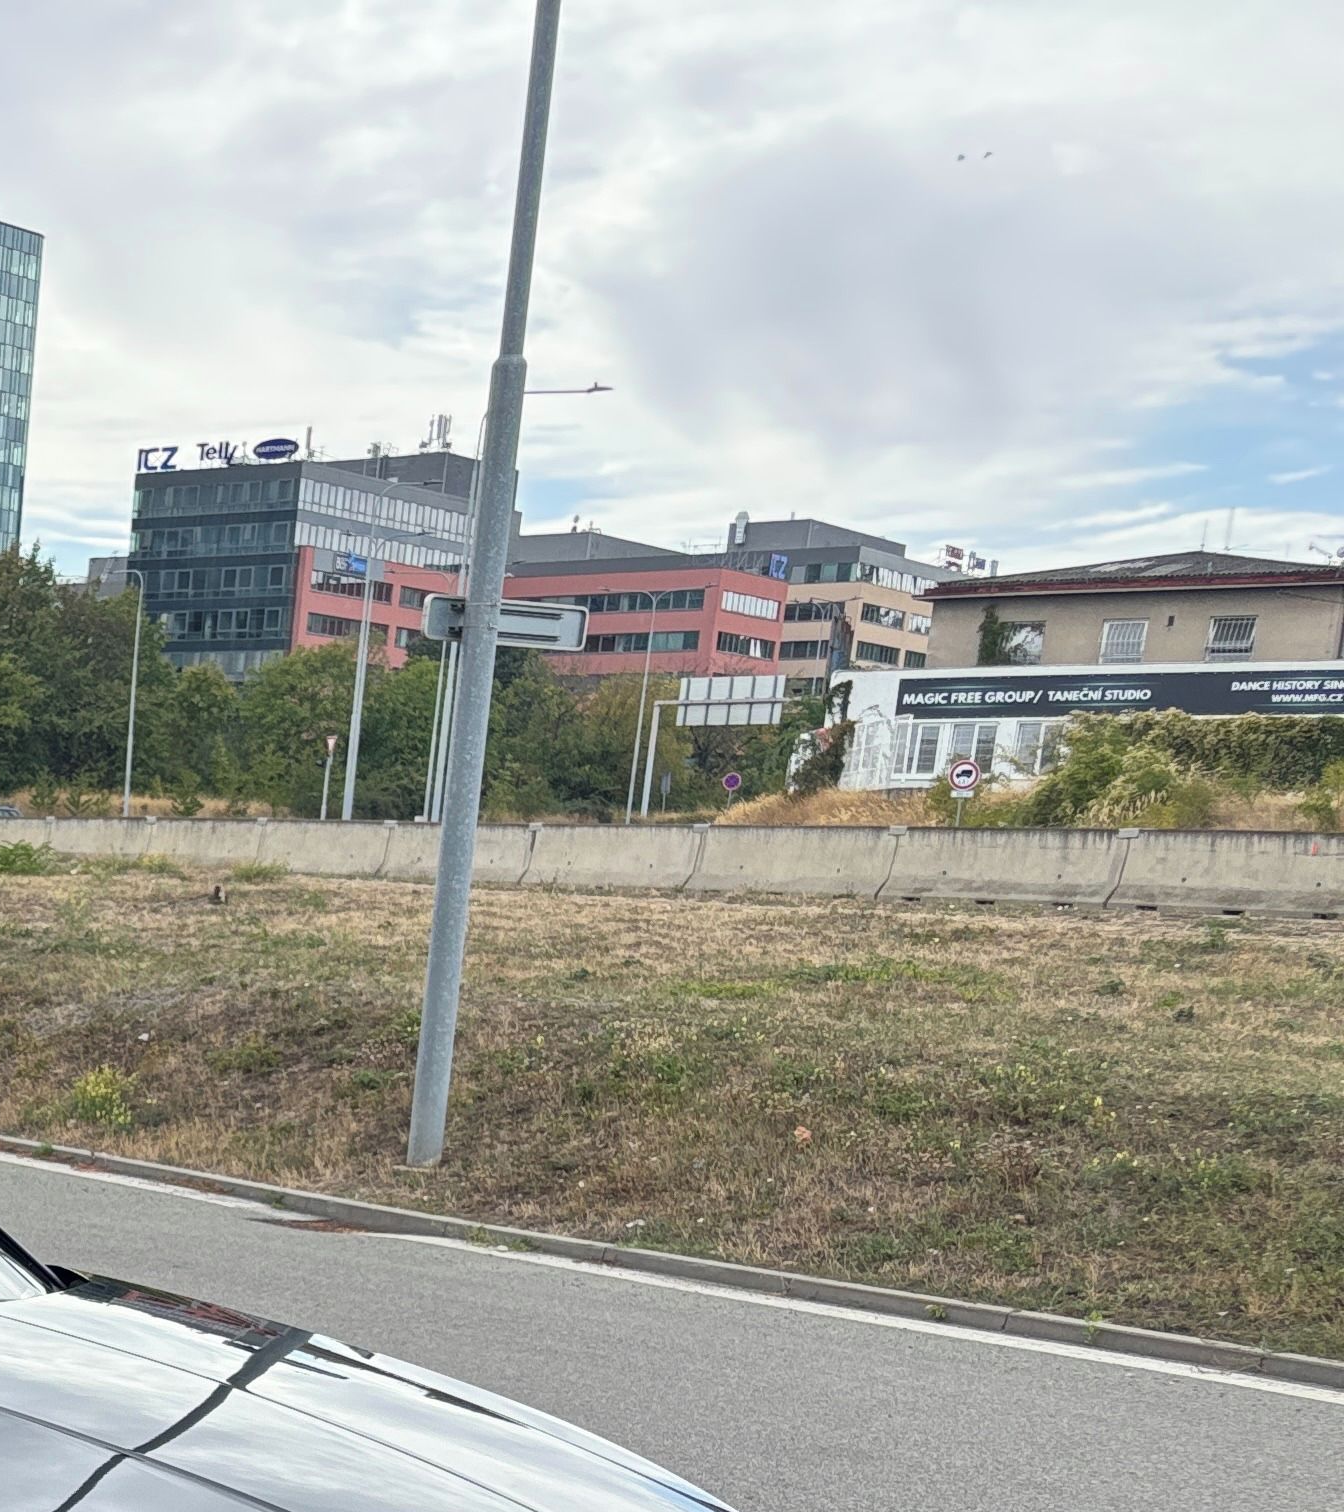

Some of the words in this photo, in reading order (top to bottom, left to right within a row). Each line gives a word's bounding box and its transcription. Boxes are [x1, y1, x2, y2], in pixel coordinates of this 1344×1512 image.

[137, 447, 179, 471] ICZ
[197, 441, 239, 466] Telly
[1231, 681, 1271, 691] DANCE
[1272, 680, 1322, 690] HISTORY
[1322, 680, 1344, 690] SIN
[902, 692, 949, 705] MAGIC
[951, 691, 982, 704] FREE
[1047, 687, 1104, 701] TANEČNÍ
[1104, 689, 1152, 701] STUDIO
[1272, 694, 1344, 702] WWW.MFG.CZ
